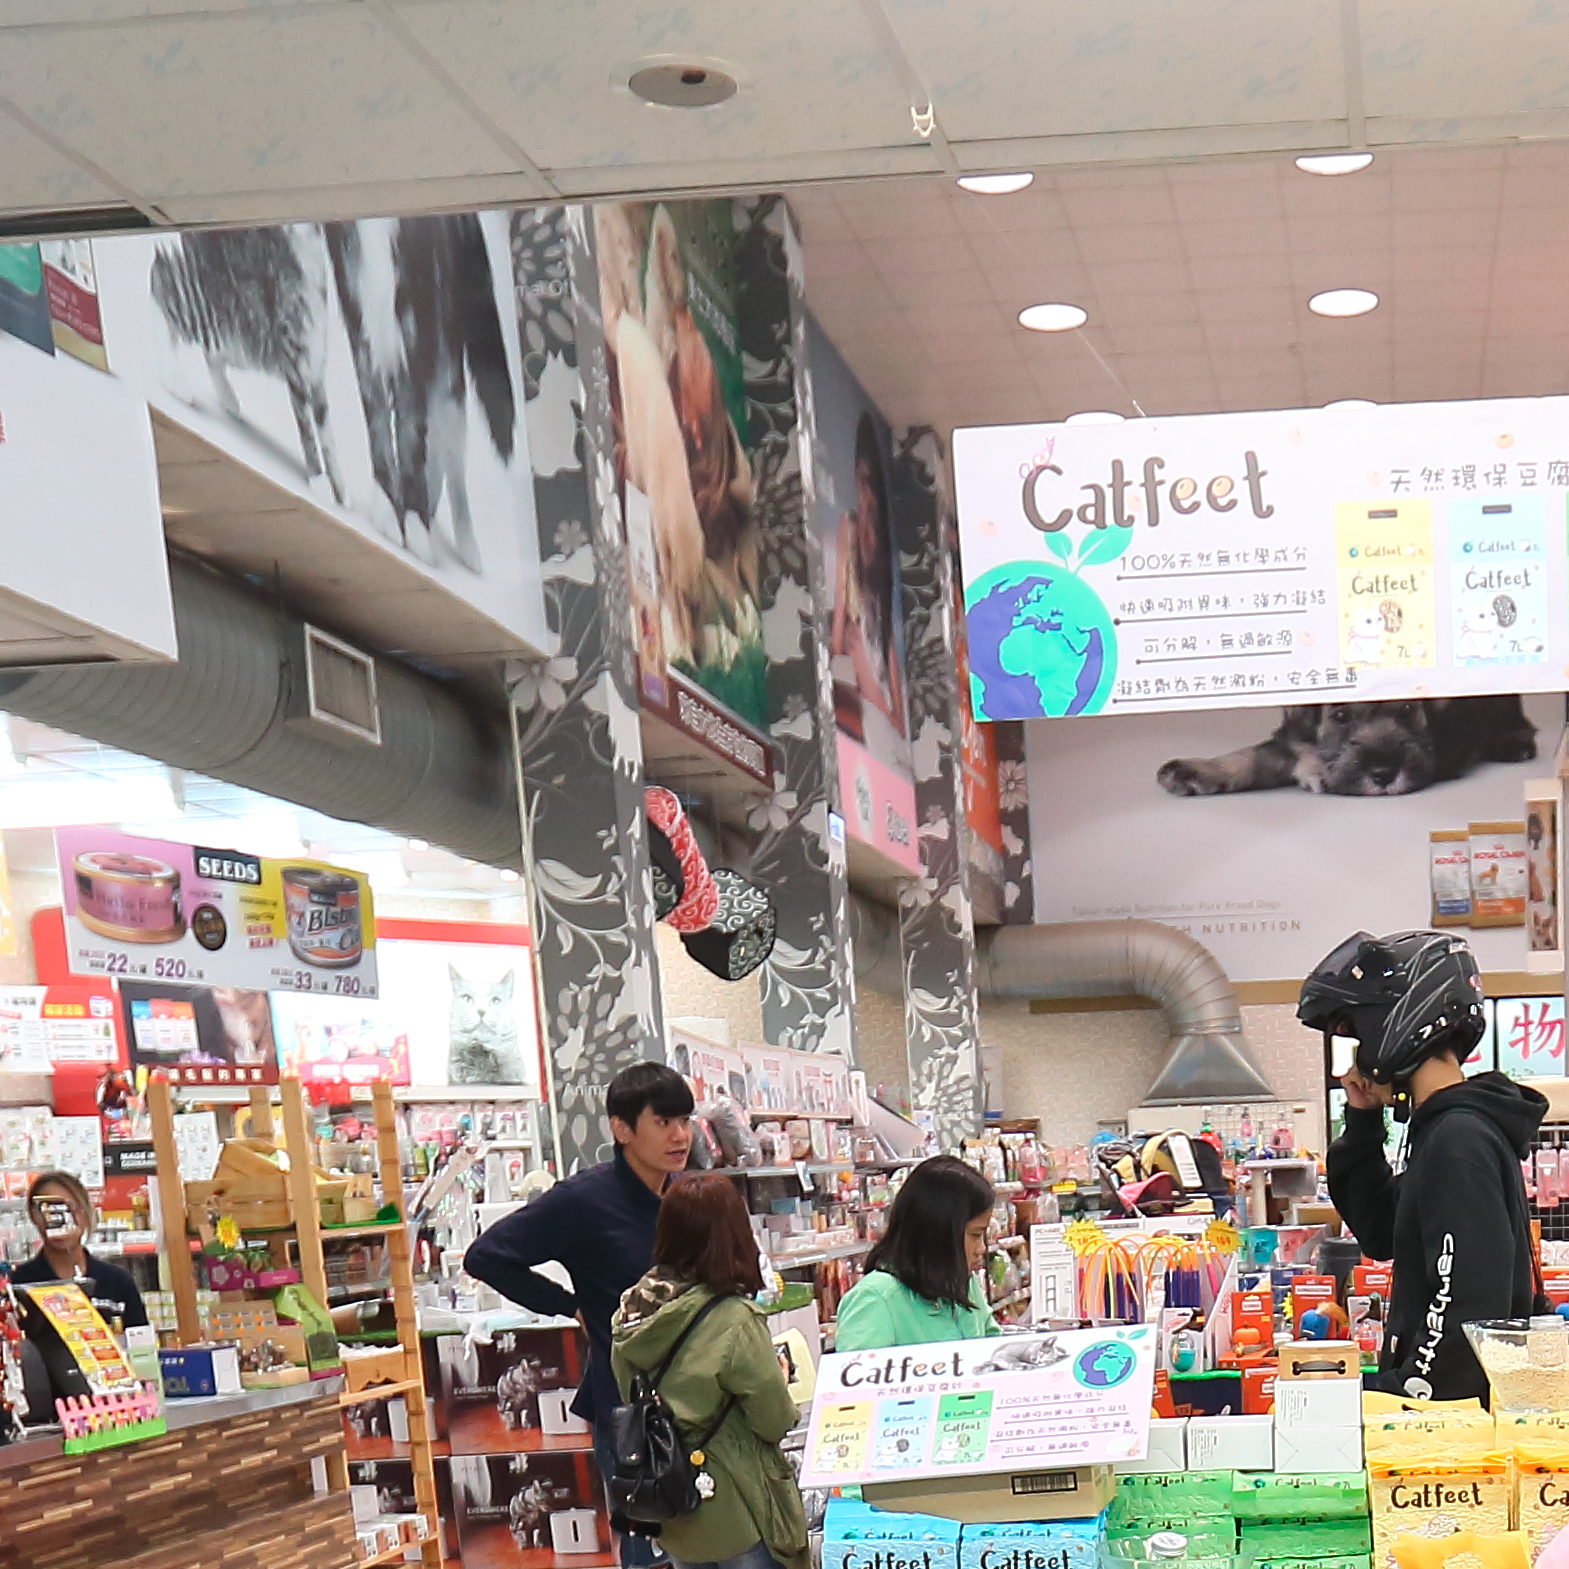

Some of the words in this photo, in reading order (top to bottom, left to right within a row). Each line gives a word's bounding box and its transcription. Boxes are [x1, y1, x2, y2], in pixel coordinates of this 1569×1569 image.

[1021, 450, 1276, 533] Catfeet
[1351, 570, 1419, 596] Catfeet
[1464, 566, 1532, 591] Catfeet
[197, 855, 260, 881] SEEDS
[1202, 919, 1302, 934] NUTRITION
[105, 953, 129, 974] 22
[154, 958, 187, 979] 520
[293, 971, 313, 991] 33
[333, 975, 361, 995] 780
[1509, 1001, 1566, 1060] 物
[840, 1351, 965, 1389] Catfeet
[1390, 1481, 1484, 1510] Catfeet
